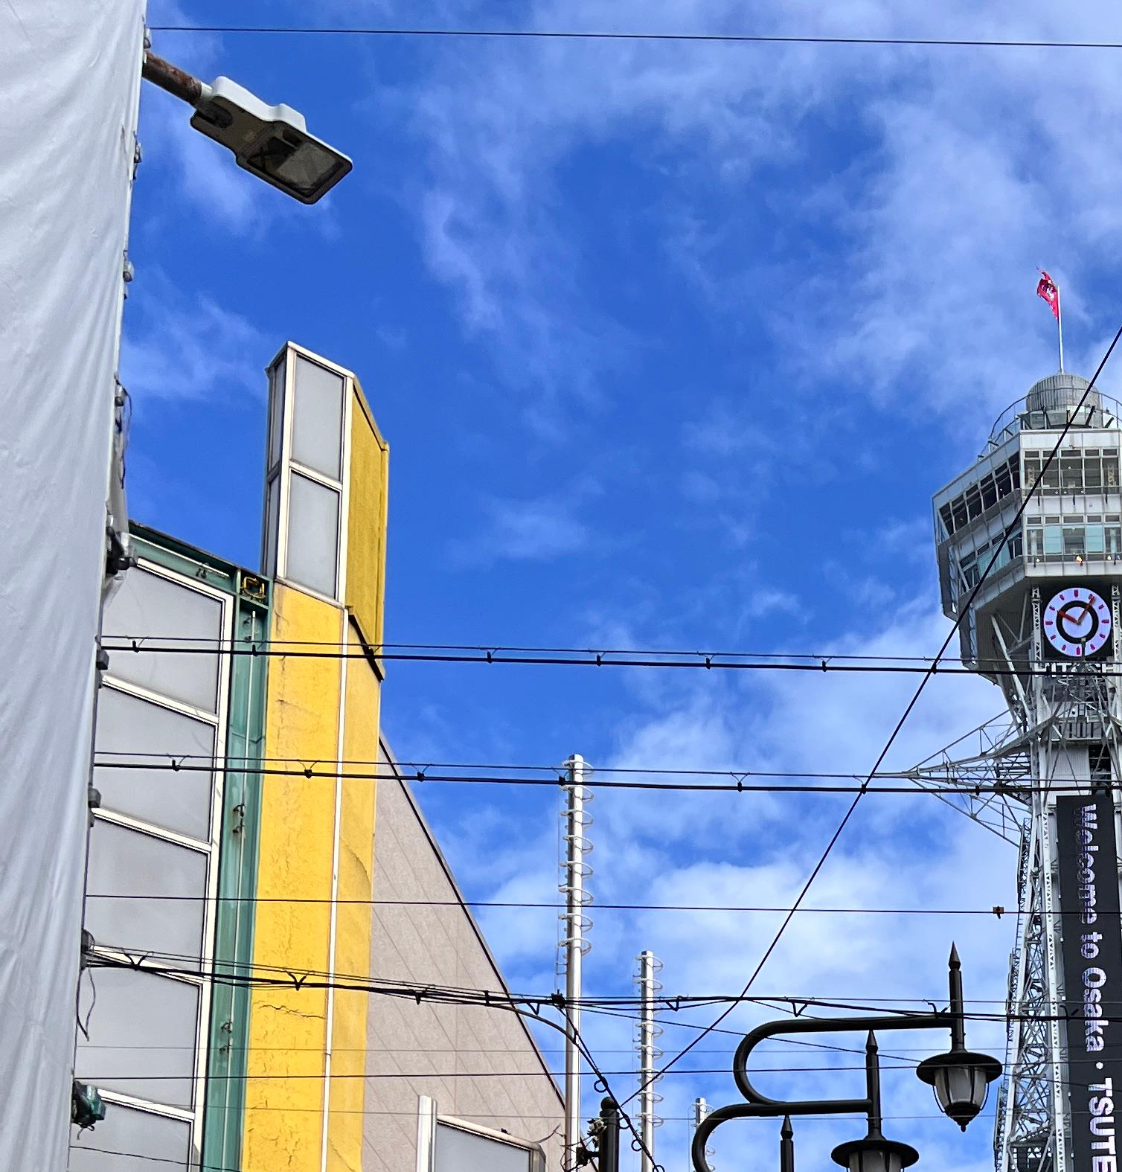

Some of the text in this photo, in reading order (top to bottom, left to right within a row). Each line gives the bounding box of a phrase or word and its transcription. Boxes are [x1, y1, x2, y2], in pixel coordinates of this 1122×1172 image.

[1073, 803, 1099, 926] Welcome
[1080, 932, 1103, 959] to
[1081, 966, 1108, 1053] Osaka
